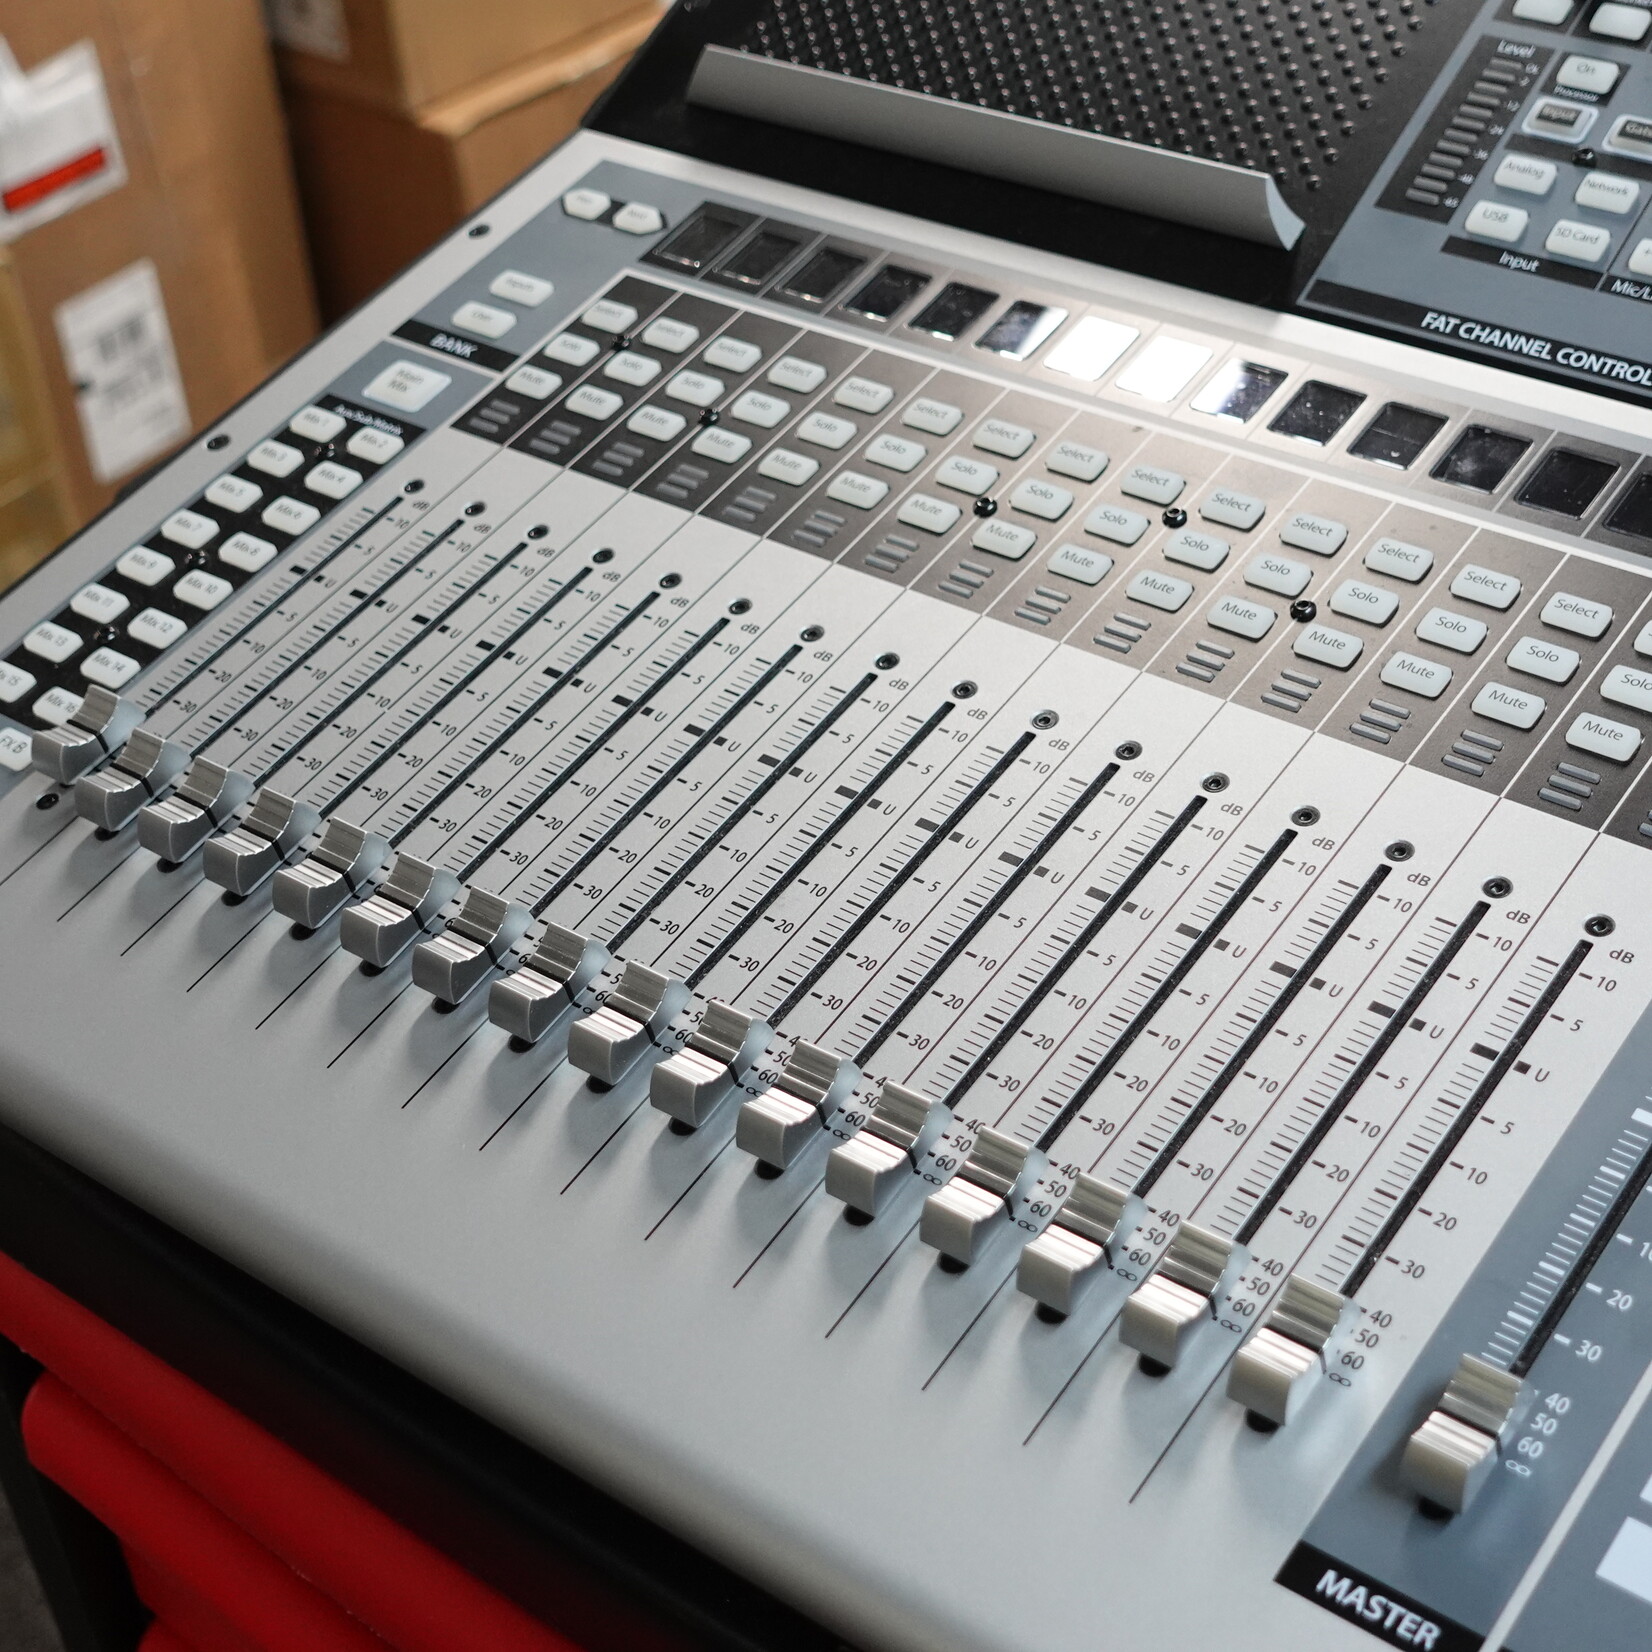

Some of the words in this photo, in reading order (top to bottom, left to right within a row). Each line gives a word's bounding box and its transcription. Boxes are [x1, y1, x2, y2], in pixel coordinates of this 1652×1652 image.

[1497, 40, 1536, 58] Level
[1576, 62, 1596, 74] On
[1625, 122, 1652, 138] Gat
[1505, 162, 1546, 180] Analog
[1482, 207, 1509, 223] USB
[1556, 226, 1572, 238] SD
[1572, 229, 1600, 244] Card
[1498, 251, 1540, 273] Input
[1610, 278, 1652, 301] Mic/L
[430, 334, 479, 358] BANK
[1420, 311, 1463, 333] FAT
[1458, 322, 1553, 361] CHANNEL
[1555, 346, 1652, 387] CONTROL
[914, 404, 948, 419] Select
[984, 425, 1020, 440] Select
[880, 441, 906, 454] Solo
[1057, 447, 1094, 463] Select
[318, 469, 336, 480] Mix
[952, 461, 978, 476] Solo
[841, 477, 870, 492] Mute
[1132, 470, 1169, 486] Select
[1025, 484, 1054, 500] Solo
[275, 504, 293, 516] Mix
[911, 499, 943, 516] Mute
[1212, 494, 1251, 512] Select
[1100, 511, 1127, 525] Solo
[986, 523, 1018, 540] Mute
[1293, 518, 1333, 536] Select
[232, 541, 249, 553] Mix
[1180, 536, 1209, 551] Solo
[130, 553, 146, 566] Mix
[1061, 551, 1094, 567] Mute
[1378, 544, 1419, 563] Select
[1261, 561, 1290, 575] Solo
[186, 575, 203, 589] Mix
[1140, 576, 1175, 594] Mute
[1464, 572, 1507, 591] Select
[1348, 588, 1378, 603] Solo
[1221, 602, 1256, 620] Mute
[1554, 599, 1598, 619] Select
[140, 614, 157, 628] Mix
[159, 622, 174, 634] 12
[1435, 617, 1467, 632] Solo
[36, 628, 54, 642] Mix
[1309, 631, 1345, 649] Mute
[93, 653, 110, 667] Mix
[813, 651, 833, 662] dB
[1527, 646, 1559, 662] Solo
[1397, 660, 1434, 679] Mute
[797, 672, 813, 683] 10
[1621, 673, 1652, 691] Solo
[45, 694, 63, 707] Mix
[1489, 690, 1527, 709] Mute
[766, 704, 778, 713] 5
[967, 708, 988, 720] dB
[952, 731, 968, 742] 10
[1583, 721, 1623, 740] Mute
[728, 741, 741, 752] U
[921, 765, 934, 774] 5
[1133, 770, 1155, 782] dB
[690, 782, 702, 791] 5
[1118, 794, 1135, 806] 10
[883, 804, 896, 815] U
[654, 816, 670, 829] 10
[1088, 830, 1101, 840] 5
[1312, 837, 1335, 850] dB
[618, 850, 637, 863] 20
[845, 847, 858, 857] 5
[1298, 862, 1316, 876] 10
[1051, 872, 1065, 884] U
[1407, 873, 1431, 886] dB
[583, 885, 602, 899] 30
[810, 884, 827, 897] 10
[1269, 901, 1282, 912] 5
[1394, 899, 1412, 912] 10
[1013, 917, 1027, 928] 5
[1506, 910, 1531, 924] dB
[774, 919, 794, 933] 20
[1232, 945, 1247, 958] U
[1365, 938, 1378, 950] 5
[1493, 937, 1512, 951] 10
[978, 956, 997, 971] 10
[1609, 949, 1634, 963] dB
[739, 957, 760, 971] 30
[1329, 984, 1343, 997] U
[1465, 978, 1479, 990] 5
[1597, 977, 1617, 992] 10
[943, 994, 964, 1009] 20
[1196, 994, 1210, 1005] 5
[1430, 1025, 1444, 1039] U
[1570, 1019, 1583, 1031] 5
[909, 1034, 930, 1050] 30
[1161, 1035, 1180, 1050] 10
[1293, 1034, 1307, 1046] 5
[1535, 1068, 1550, 1082] U
[1126, 1076, 1148, 1092] 20
[1259, 1077, 1278, 1093] 10
[1394, 1077, 1408, 1089] 5
[1093, 1119, 1115, 1135] 30
[1224, 1119, 1246, 1136] 20
[1361, 1122, 1381, 1138] 10
[1500, 1122, 1515, 1134] 5
[1191, 1163, 1214, 1181] 30
[1326, 1165, 1349, 1182] 20
[1467, 1168, 1487, 1184] 10
[1045, 1180, 1067, 1198] 50
[1030, 1201, 1051, 1218] 60
[1158, 1210, 1180, 1227] 40
[1294, 1210, 1317, 1228] 30
[1433, 1212, 1457, 1230] 20
[1143, 1227, 1166, 1245] 50
[1128, 1249, 1151, 1266] 60
[1261, 1259, 1283, 1276] 40
[1401, 1260, 1425, 1278] 30
[1247, 1277, 1270, 1296] 50
[1232, 1299, 1255, 1317] 60
[1606, 1289, 1634, 1312] 20
[1369, 1310, 1392, 1328] 40
[1355, 1329, 1379, 1348] 50
[1575, 1339, 1603, 1362] 30
[1341, 1351, 1364, 1370] 60
[1544, 1392, 1571, 1415] 40
[1530, 1411, 1558, 1436] 50
[1517, 1436, 1544, 1459] 60
[1315, 1569, 1442, 1651] MASTER
